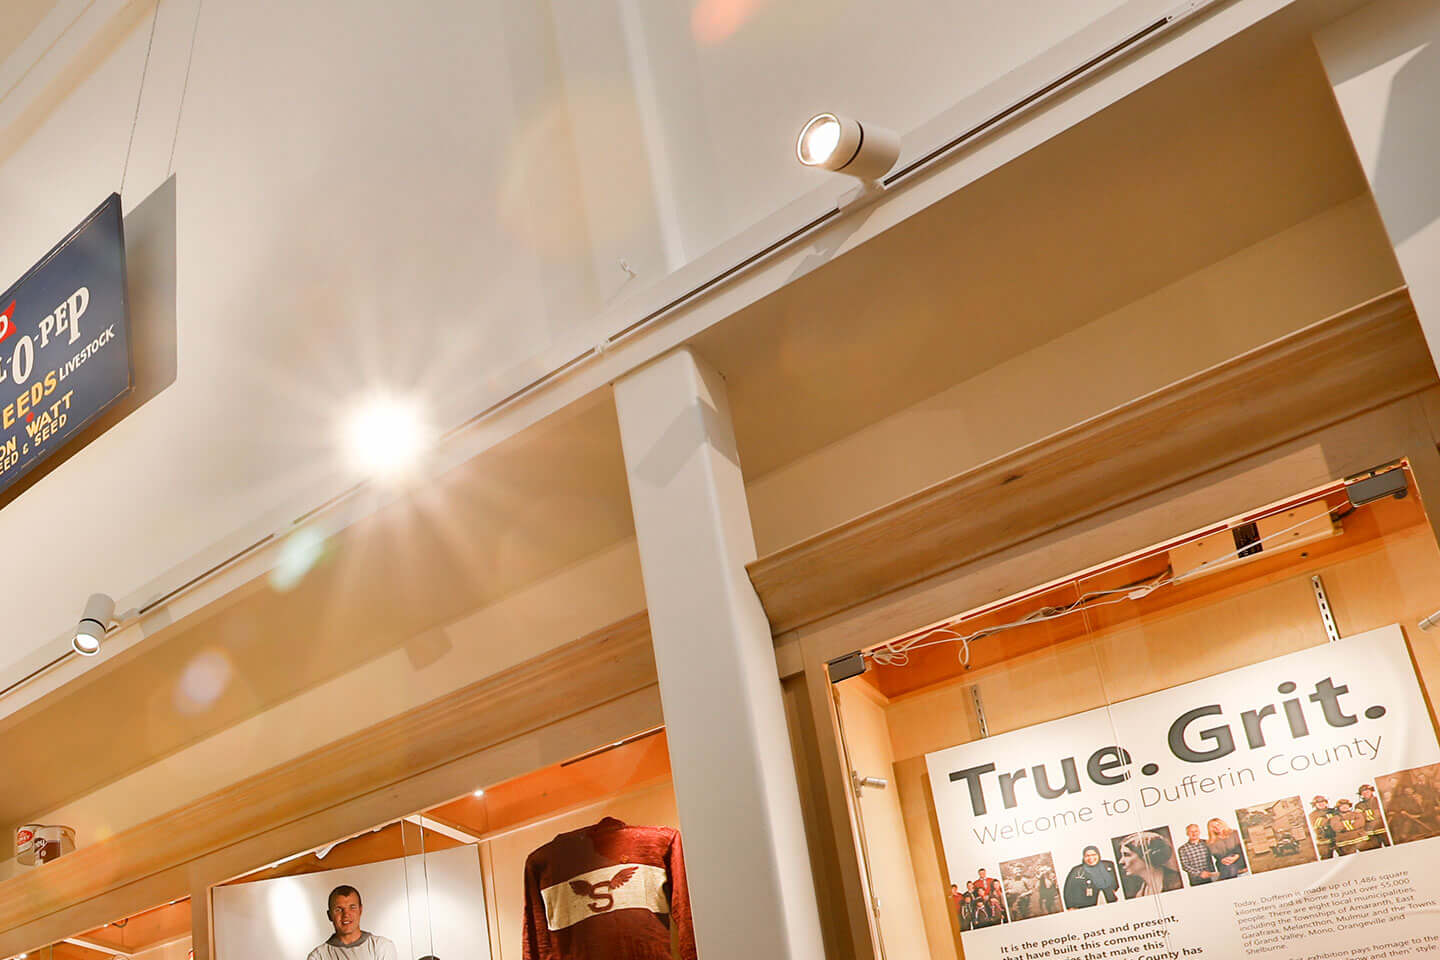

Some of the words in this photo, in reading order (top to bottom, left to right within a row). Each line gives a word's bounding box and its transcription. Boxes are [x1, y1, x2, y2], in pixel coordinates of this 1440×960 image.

[59, 324, 115, 381] LIVESTOCK
[25, 390, 74, 438] WATT
[34, 413, 67, 447] SEED
[949, 742, 1159, 817] True.
[1166, 675, 1388, 765] Grit.
[973, 804, 1094, 848] Welcome
[1102, 797, 1130, 817] to
[1139, 765, 1256, 809] Dufferin
[1266, 734, 1384, 777] County
[1022, 941, 1038, 949] the
[1083, 928, 1105, 940] past
[1109, 923, 1130, 934] and
[1026, 951, 1051, 959] have
[1053, 945, 1077, 955] built
[1080, 941, 1101, 950] this
[1084, 951, 1106, 960] that
[1110, 946, 1140, 956] make
[1143, 941, 1164, 950] this
[1182, 947, 1203, 955] has
[1351, 947, 1369, 955] pays
[1370, 952, 1387, 960] and
